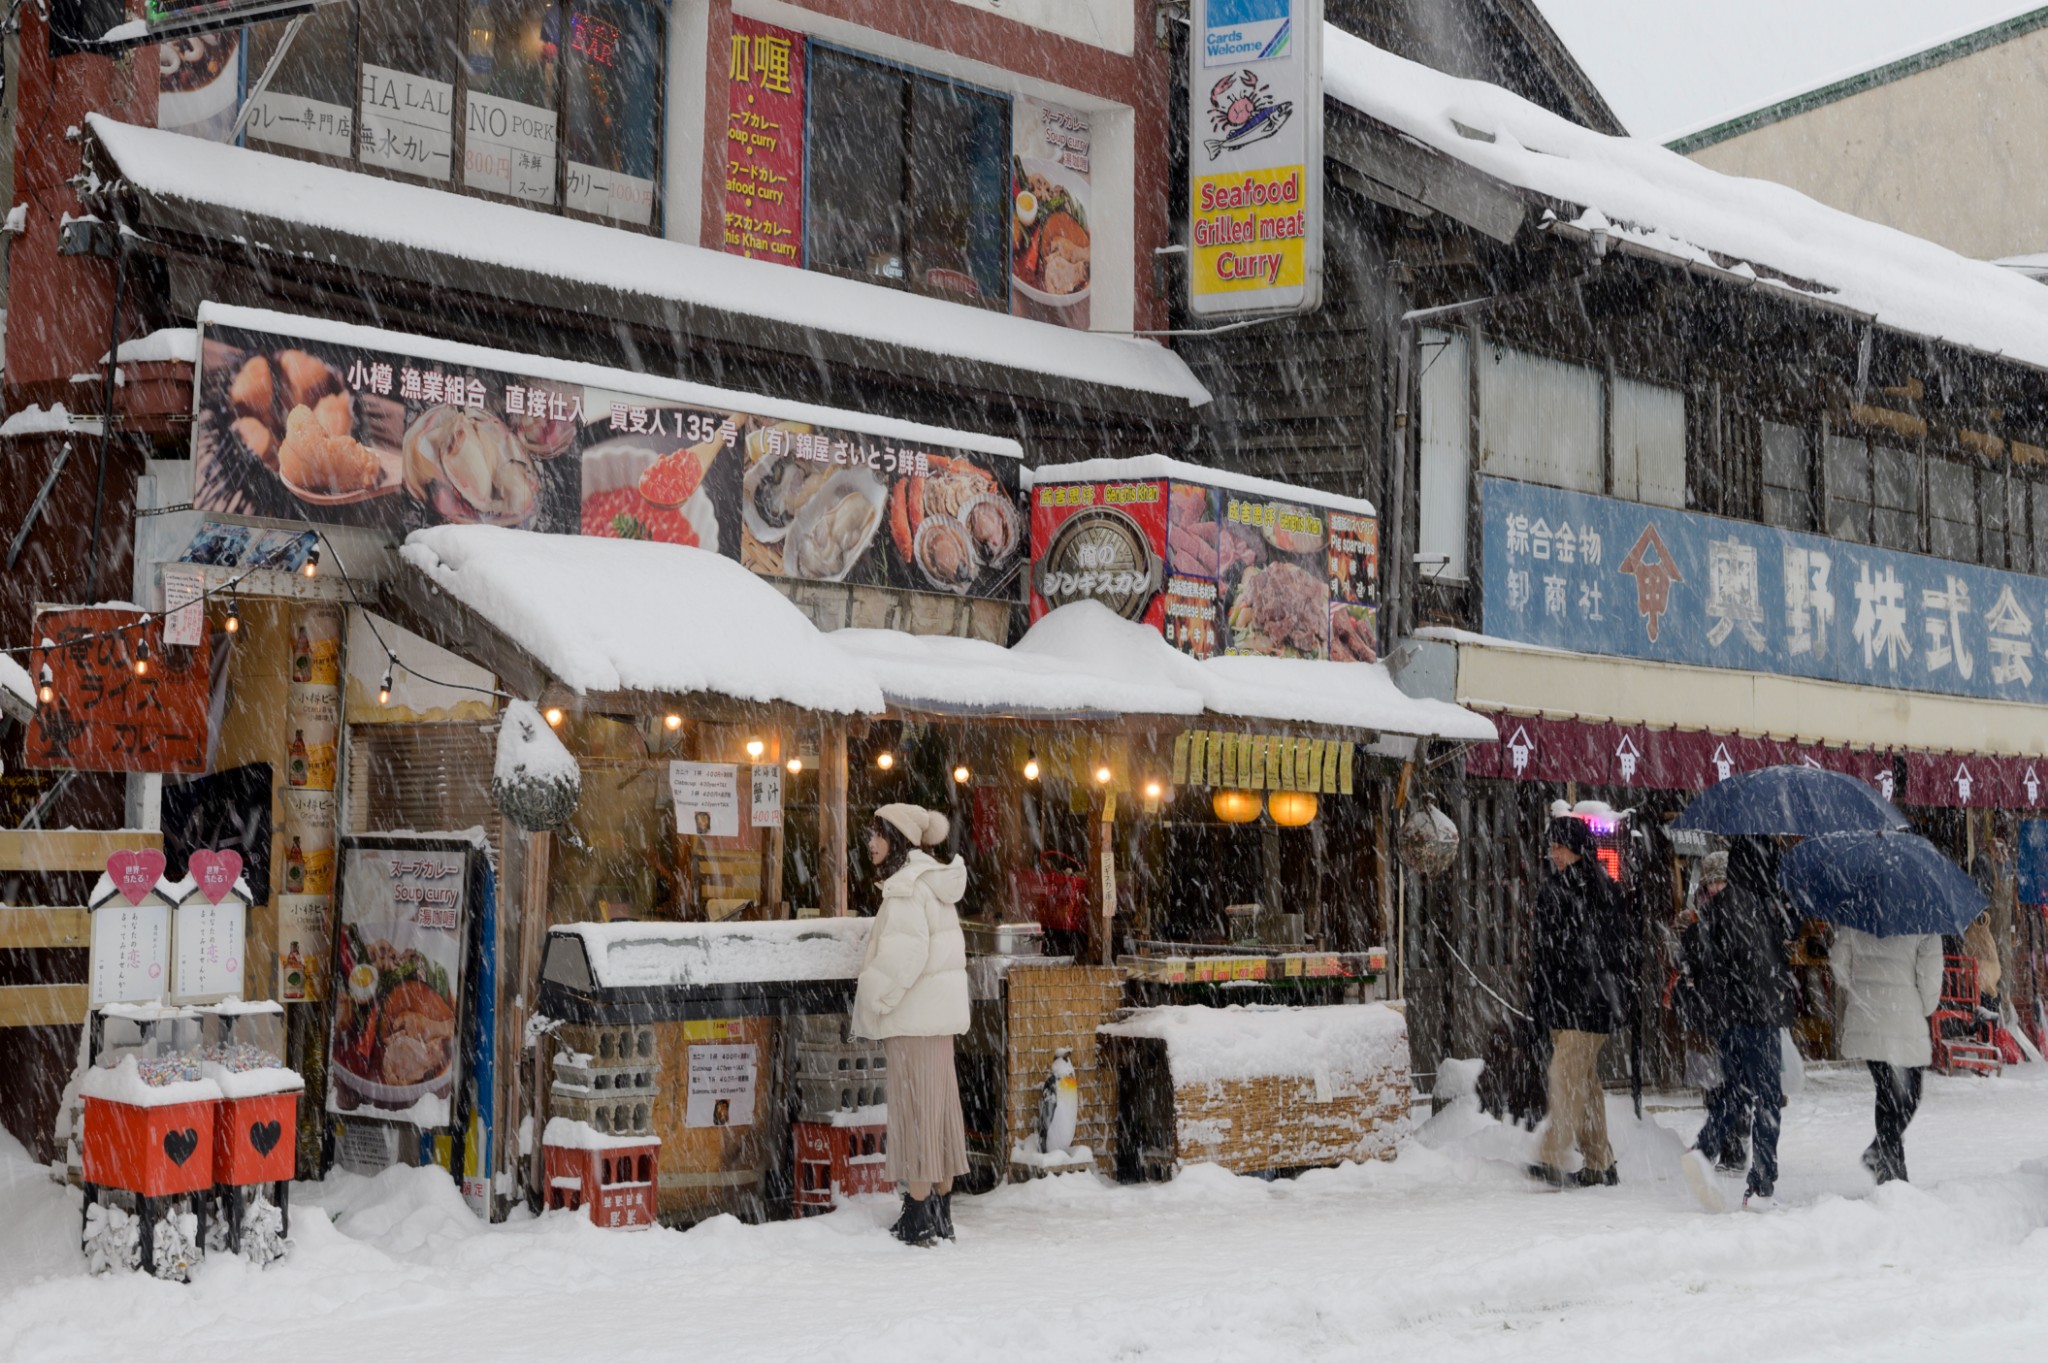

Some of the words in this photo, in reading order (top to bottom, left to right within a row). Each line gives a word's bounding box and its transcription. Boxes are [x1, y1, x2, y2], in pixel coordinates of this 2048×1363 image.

[1206, 32, 1243, 45] Cards
[1206, 40, 1262, 57] Welcome
[468, 102, 508, 138] NO
[512, 115, 555, 143] PORK
[1042, 107, 1089, 131] スープカレー
[360, 124, 450, 163] 無水カレー
[751, 133, 777, 151] curry
[519, 181, 549, 199] スープ
[567, 170, 609, 198] カリー
[1200, 172, 1298, 211] Seafood
[758, 187, 784, 206] curry
[1193, 213, 1254, 247] Grilled
[1259, 210, 1304, 238] meat
[742, 233, 769, 251] Khan
[771, 239, 797, 260] curry
[1216, 251, 1282, 284] Curry
[347, 359, 393, 396] 小樽
[400, 366, 487, 410] 漁業組合
[504, 384, 589, 427] 直接仕入
[1104, 484, 1138, 506] Genghis
[1137, 483, 1160, 504] Khan
[1279, 511, 1306, 534] Genghis
[1305, 513, 1323, 536] Khan
[1043, 570, 1151, 597] ジンギスカン
[1167, 599, 1199, 618] Japanese
[1200, 605, 1216, 621] beef
[125, 866, 149, 875] 世界一
[206, 866, 227, 875] 世界一
[390, 859, 458, 878] スープカレー
[394, 884, 423, 905] Soup
[425, 887, 458, 908] curry
